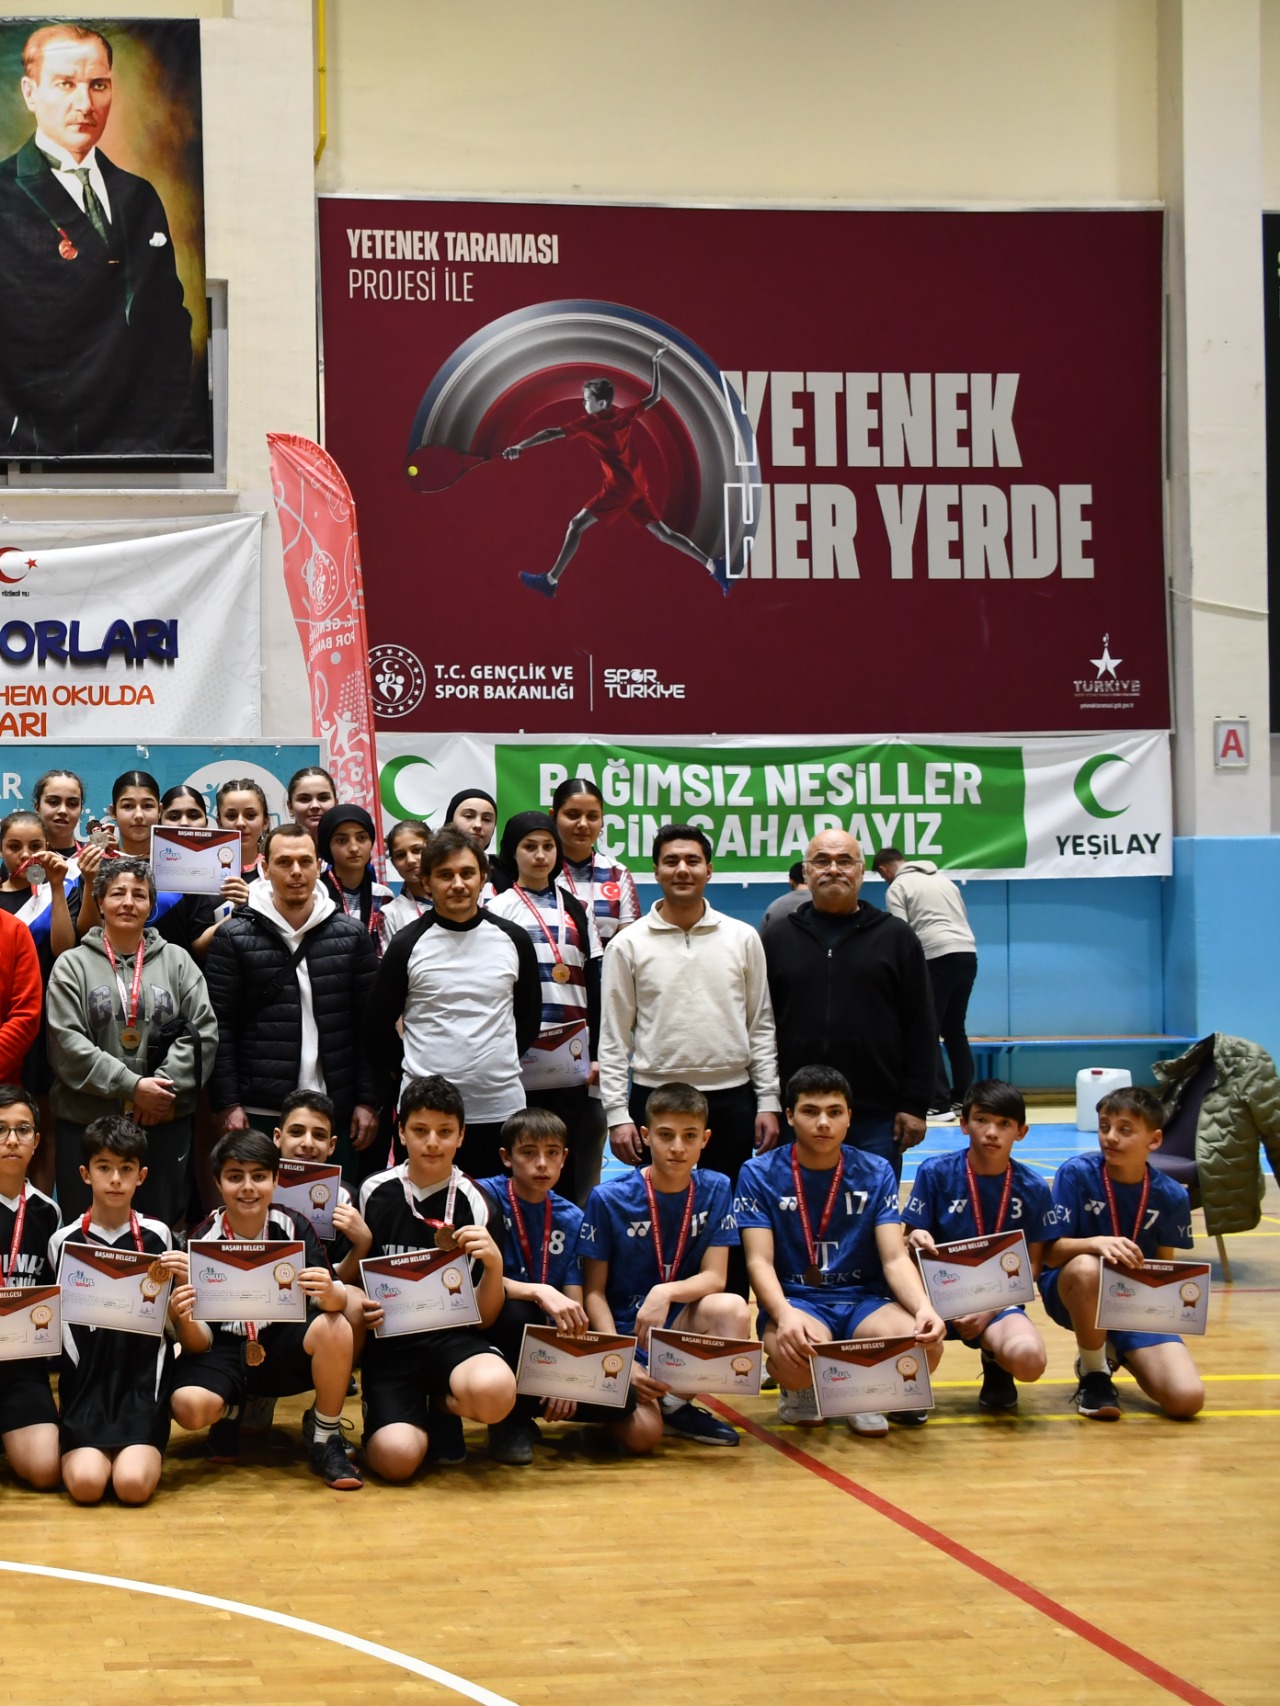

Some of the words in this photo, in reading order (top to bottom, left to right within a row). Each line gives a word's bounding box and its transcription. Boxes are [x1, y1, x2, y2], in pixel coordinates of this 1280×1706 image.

[346, 228, 440, 261] YETENEK
[444, 231, 559, 264] TARAMASI
[348, 267, 437, 301] PROJESİ
[444, 268, 475, 302] İLE
[720, 370, 1023, 468] YETENEK
[724, 483, 860, 580] HER
[875, 484, 1095, 580] YERDE
[434, 664, 467, 682] T.C.
[471, 662, 545, 685] GENÇLİK
[552, 665, 574, 682] VE
[604, 667, 658, 684] SPOR
[52, 684, 156, 707] OKULDA
[434, 684, 478, 700] SPOR
[483, 682, 574, 701] BAKANLIĞI
[604, 681, 686, 699] TÜRKİYE
[1221, 729, 1243, 758] A
[765, 761, 983, 806] NESİLLER
[1056, 831, 1162, 861] YEŞİLAY
[844, 1190, 869, 1216] 17
[1143, 1209, 1160, 1230] 7
